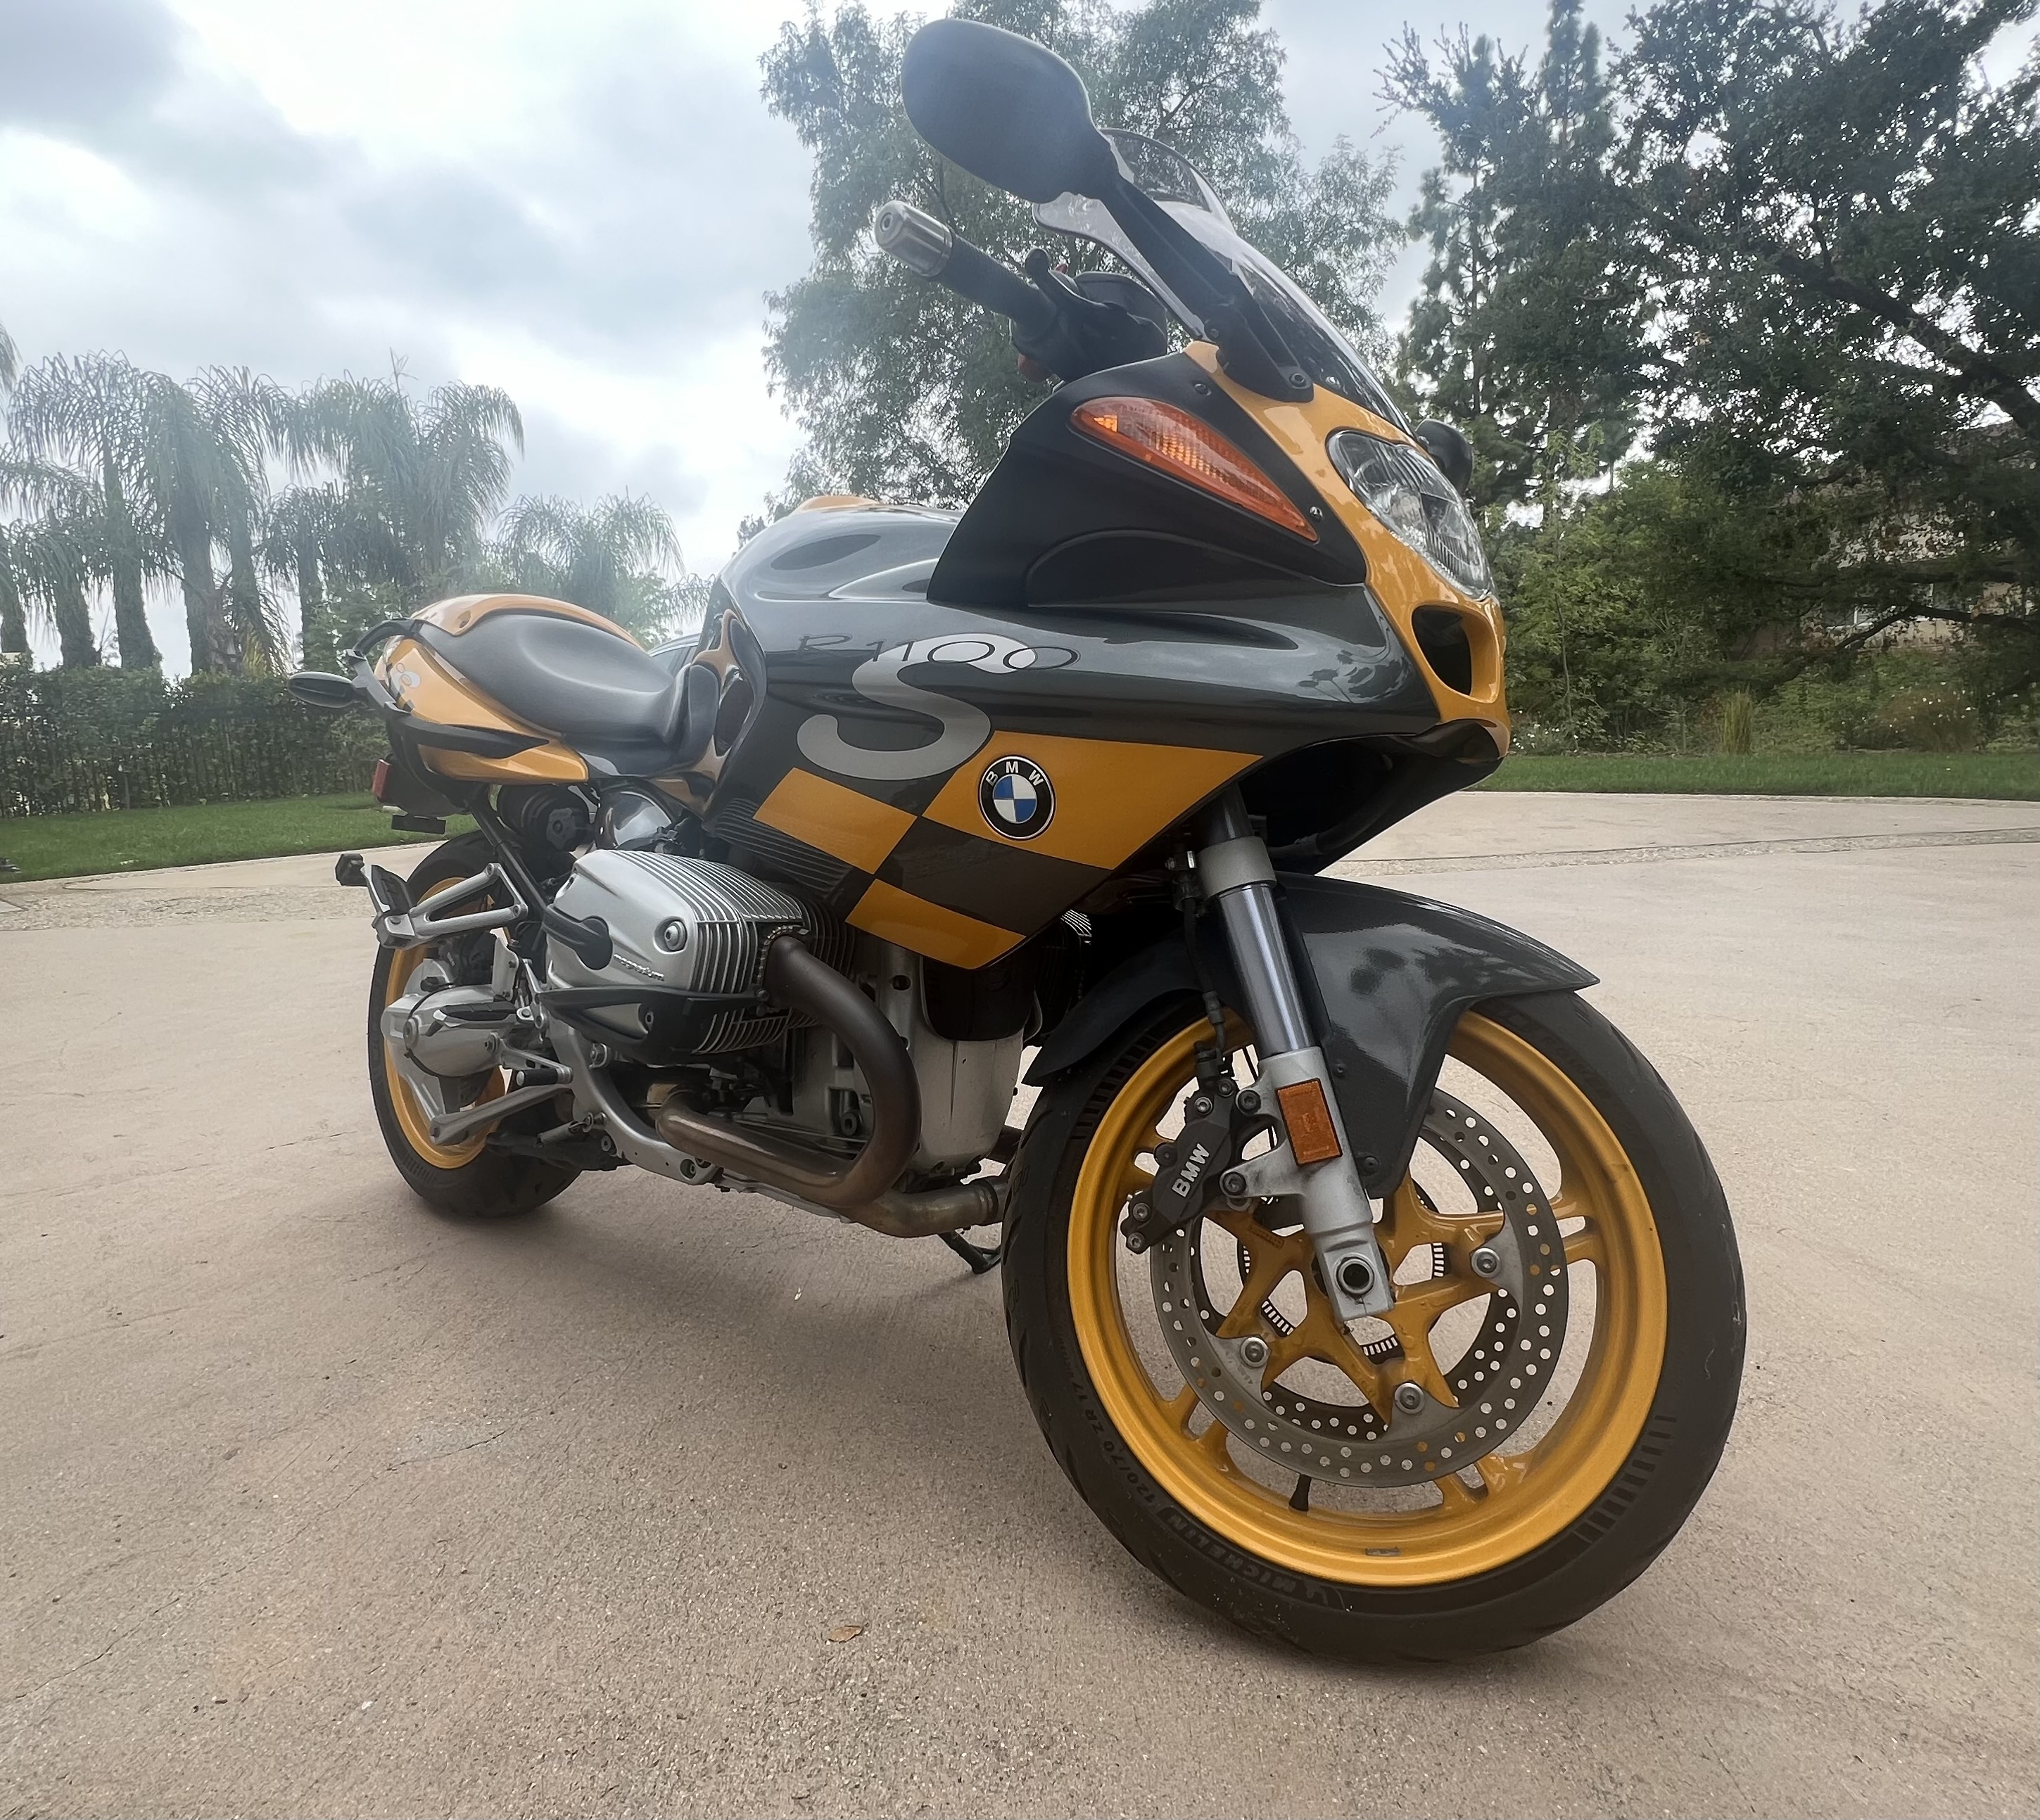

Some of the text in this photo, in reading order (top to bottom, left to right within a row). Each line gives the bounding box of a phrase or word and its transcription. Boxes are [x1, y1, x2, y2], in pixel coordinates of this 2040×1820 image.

[797, 632, 1038, 781] S
[985, 761, 1044, 787] BMW
[1171, 1143, 1211, 1198] BMW
[1072, 1382, 1155, 1504] 120/70 ZR 17
[1167, 1513, 1297, 1594] MICHELIN
